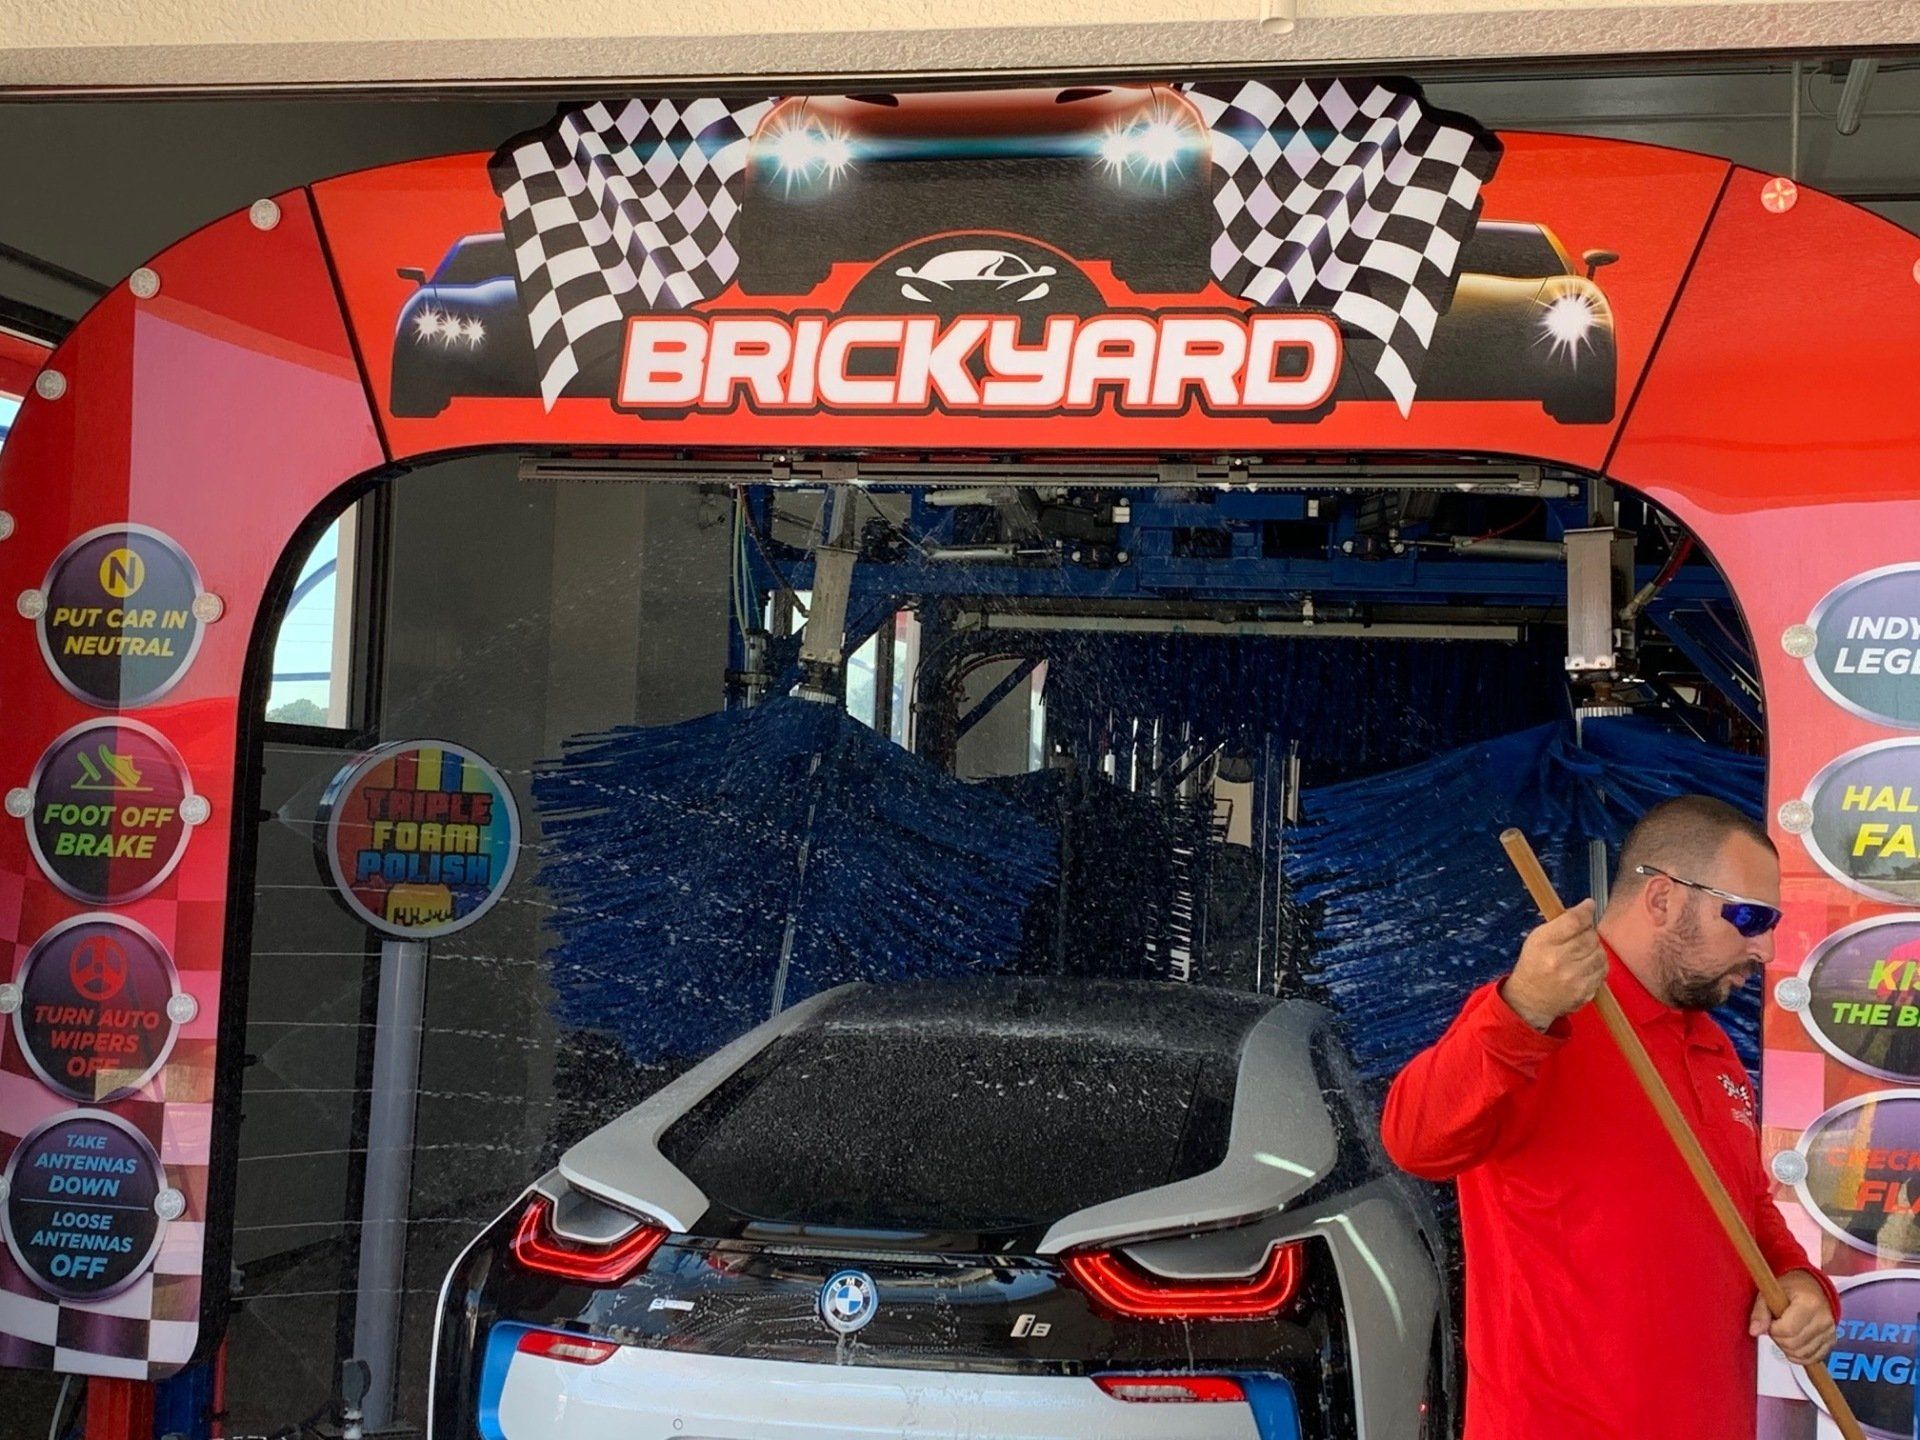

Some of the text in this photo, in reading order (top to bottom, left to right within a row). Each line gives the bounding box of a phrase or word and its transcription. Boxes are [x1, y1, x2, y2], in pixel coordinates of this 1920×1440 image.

[619, 316, 1341, 409] BRICKYARD
[109, 556, 136, 589] N
[53, 608, 188, 629] PUT CAR IN
[64, 636, 174, 656] NEUTRAL
[43, 804, 175, 828] FOOT OFF
[363, 787, 493, 825] TRIPLE
[55, 832, 157, 859] BRAKE
[373, 821, 480, 853] FOAM
[1852, 823, 1920, 858] FA
[357, 851, 491, 885] POLISH
[34, 1005, 160, 1030] TURN AUTO
[1832, 1002, 1892, 1026] THE
[50, 1030, 139, 1053] WIPERS
[66, 1134, 108, 1149] TAKE
[34, 1153, 138, 1174] ANTENNAS
[48, 1175, 120, 1197] DOWN
[52, 1211, 113, 1230] LOOSE
[30, 1230, 133, 1253] ANTENNAS
[50, 1254, 108, 1280] OFF
[1836, 1319, 1918, 1344] START
